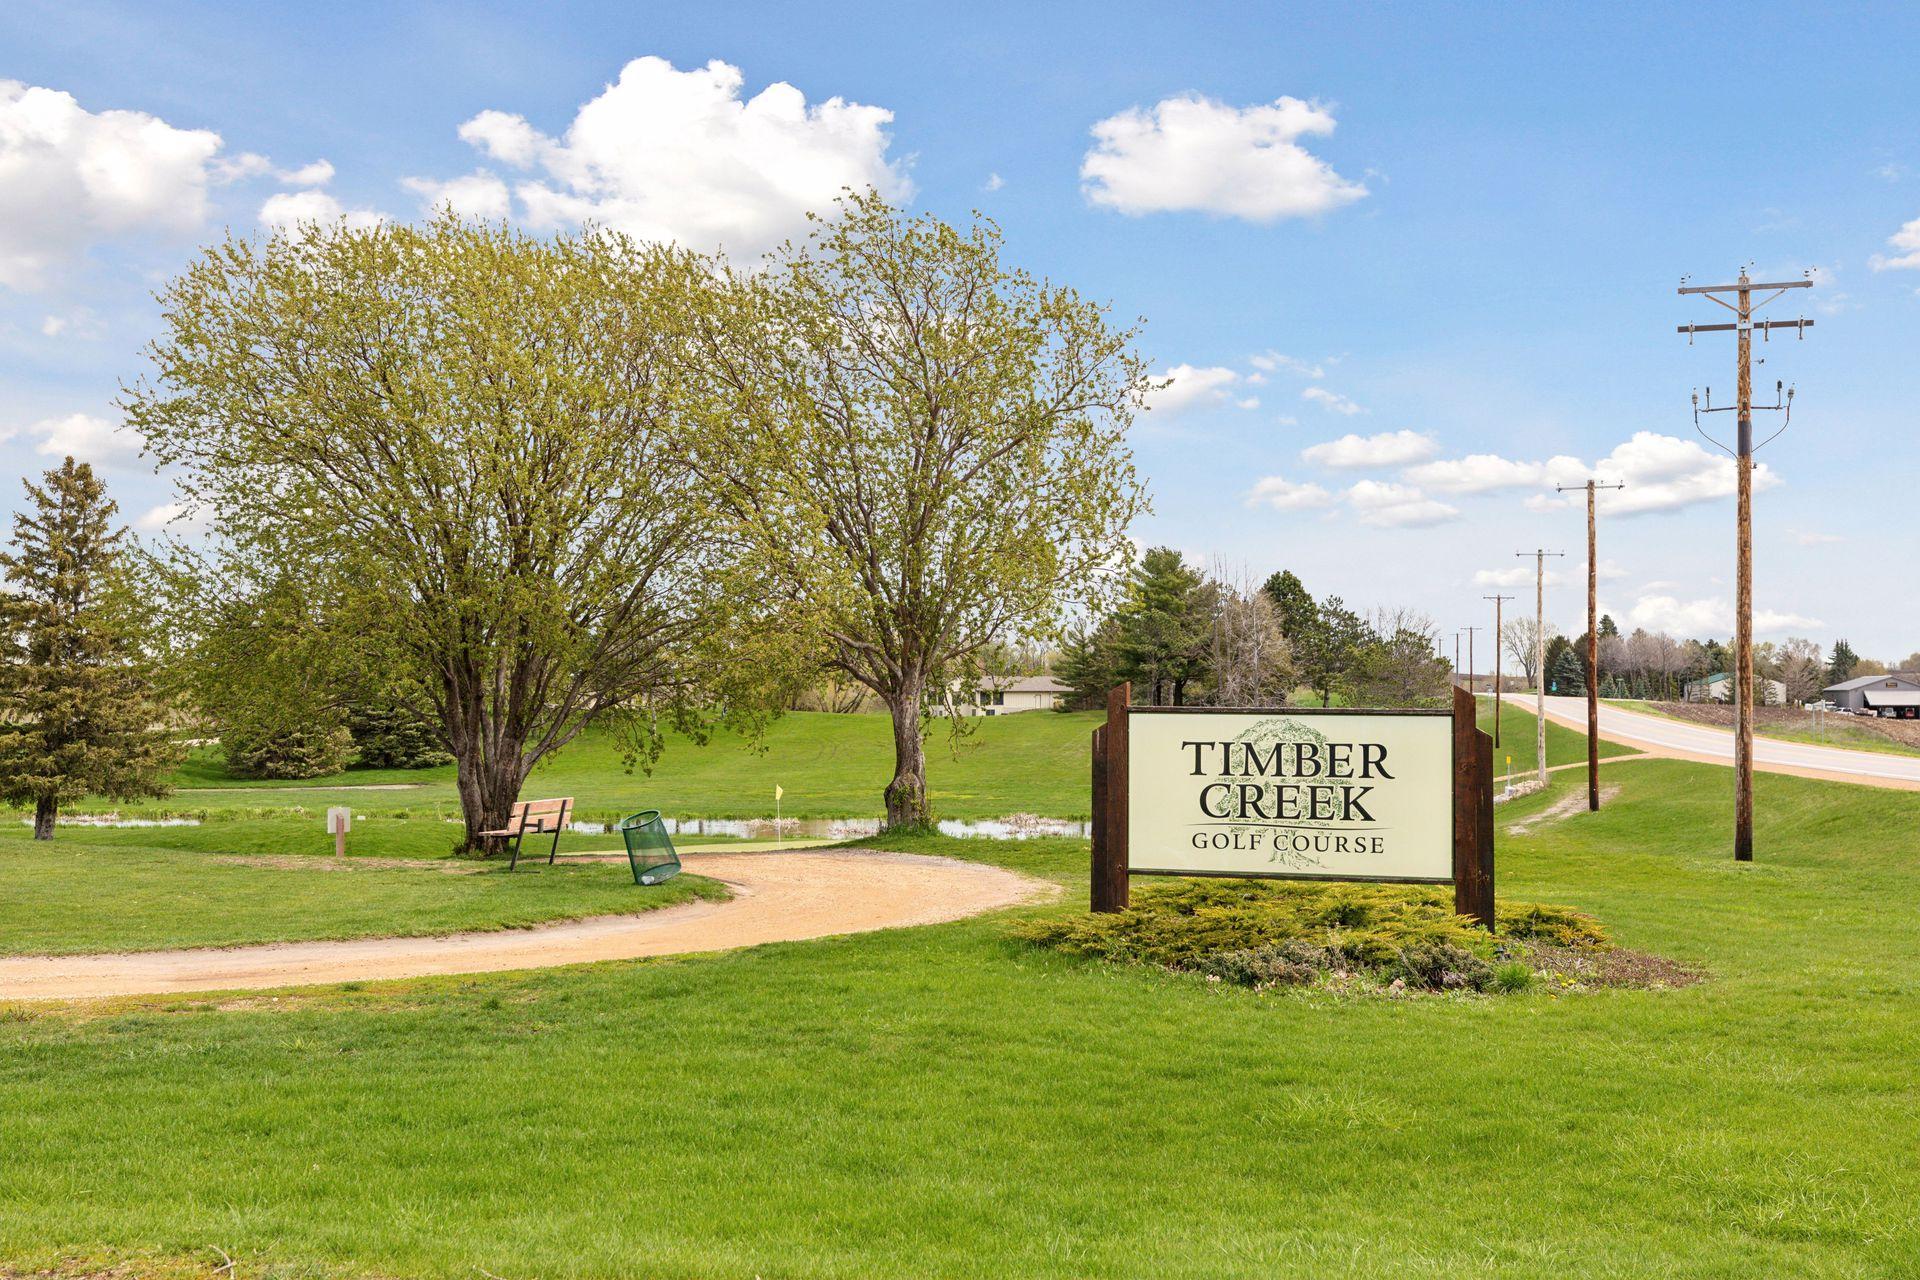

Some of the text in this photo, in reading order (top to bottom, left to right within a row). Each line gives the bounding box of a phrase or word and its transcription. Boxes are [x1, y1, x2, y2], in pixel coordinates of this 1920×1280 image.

[1182, 741, 1395, 779] TIMBER
[1199, 783, 1376, 822] CREEK
[1192, 832, 1385, 854] GOLF COURSE
